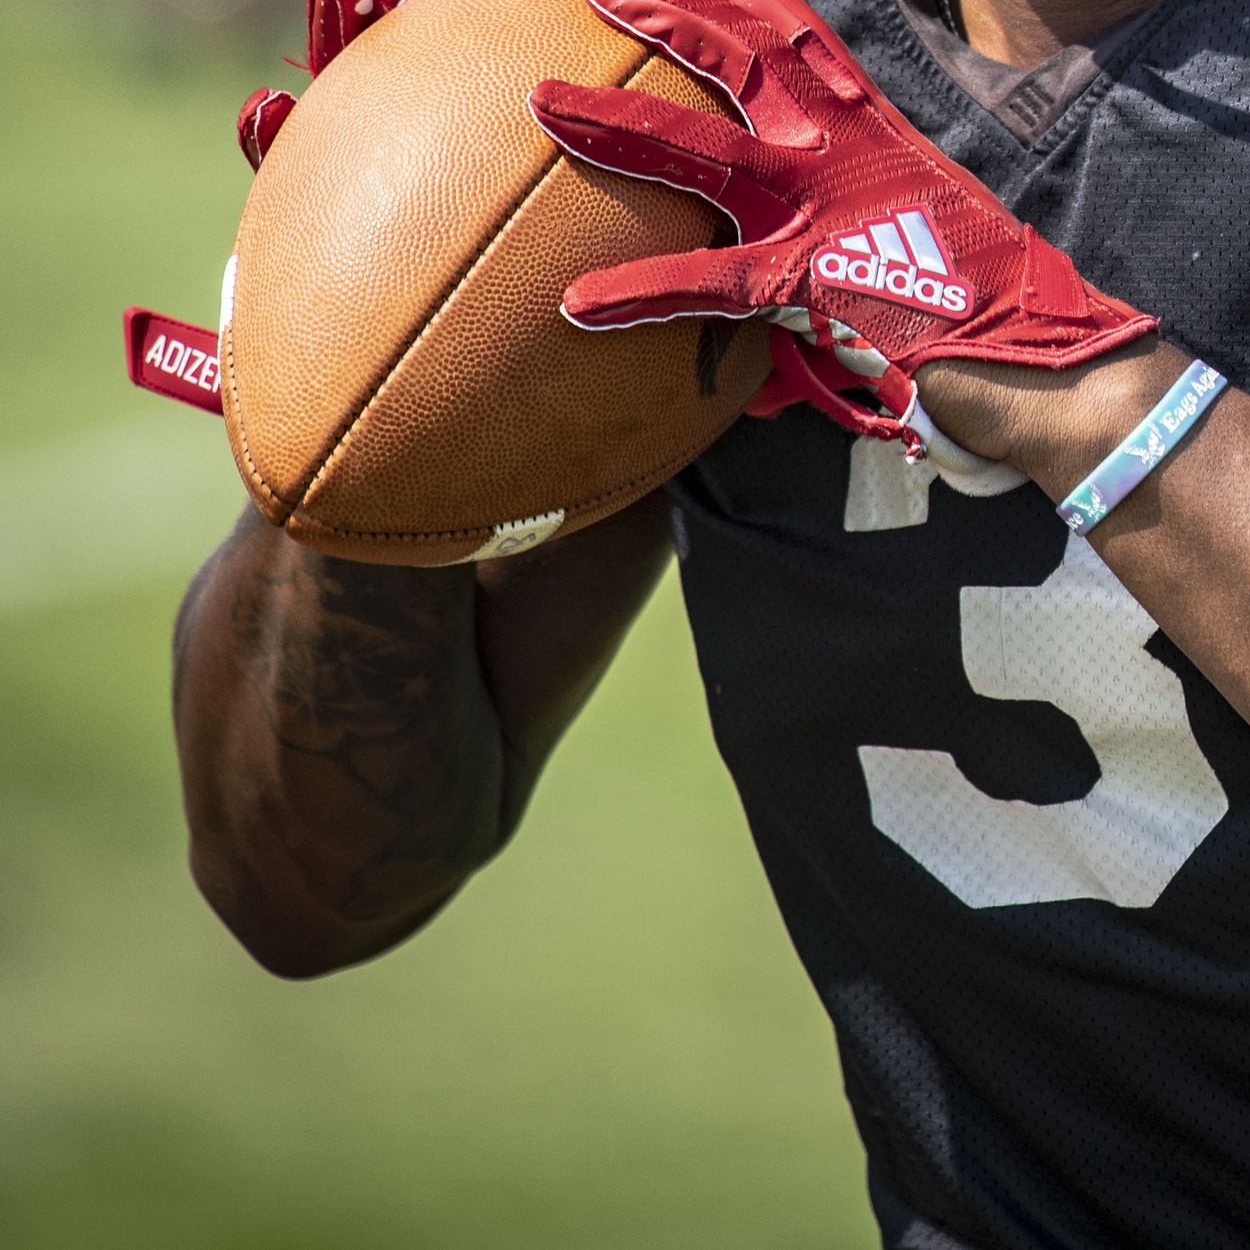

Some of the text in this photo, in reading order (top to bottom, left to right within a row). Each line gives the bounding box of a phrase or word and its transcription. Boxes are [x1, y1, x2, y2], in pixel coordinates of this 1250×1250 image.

[817, 252, 967, 312] adidas
[145, 334, 221, 393] ADIZE
[844, 437, 1229, 909] 3
